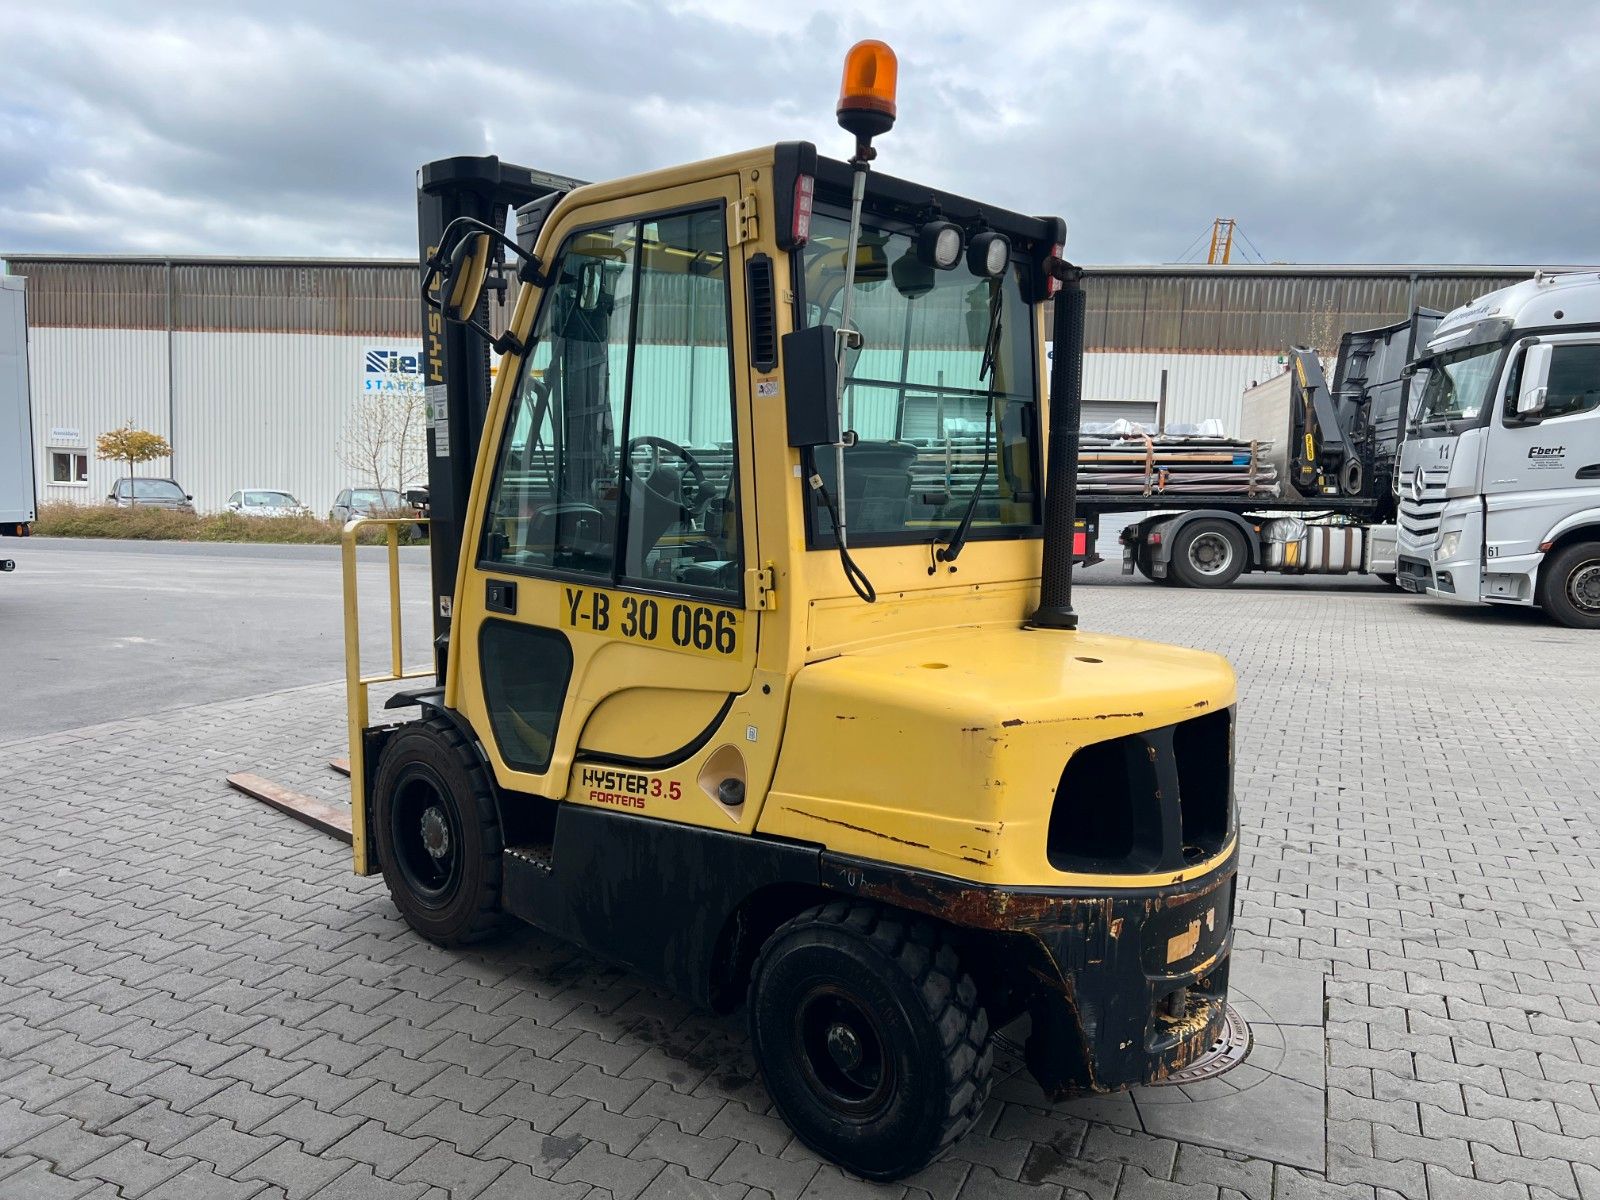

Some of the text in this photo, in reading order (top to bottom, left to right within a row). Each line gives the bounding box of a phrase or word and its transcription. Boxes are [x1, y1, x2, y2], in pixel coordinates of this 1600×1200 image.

[1439, 444, 1450, 460] 11
[1528, 446, 1566, 458] Ebert
[1488, 546, 1499, 557] 61
[566, 588, 736, 654] Y-B 30 066
[582, 768, 682, 801] HYSTER 3.5
[589, 790, 646, 809] FORTENS
